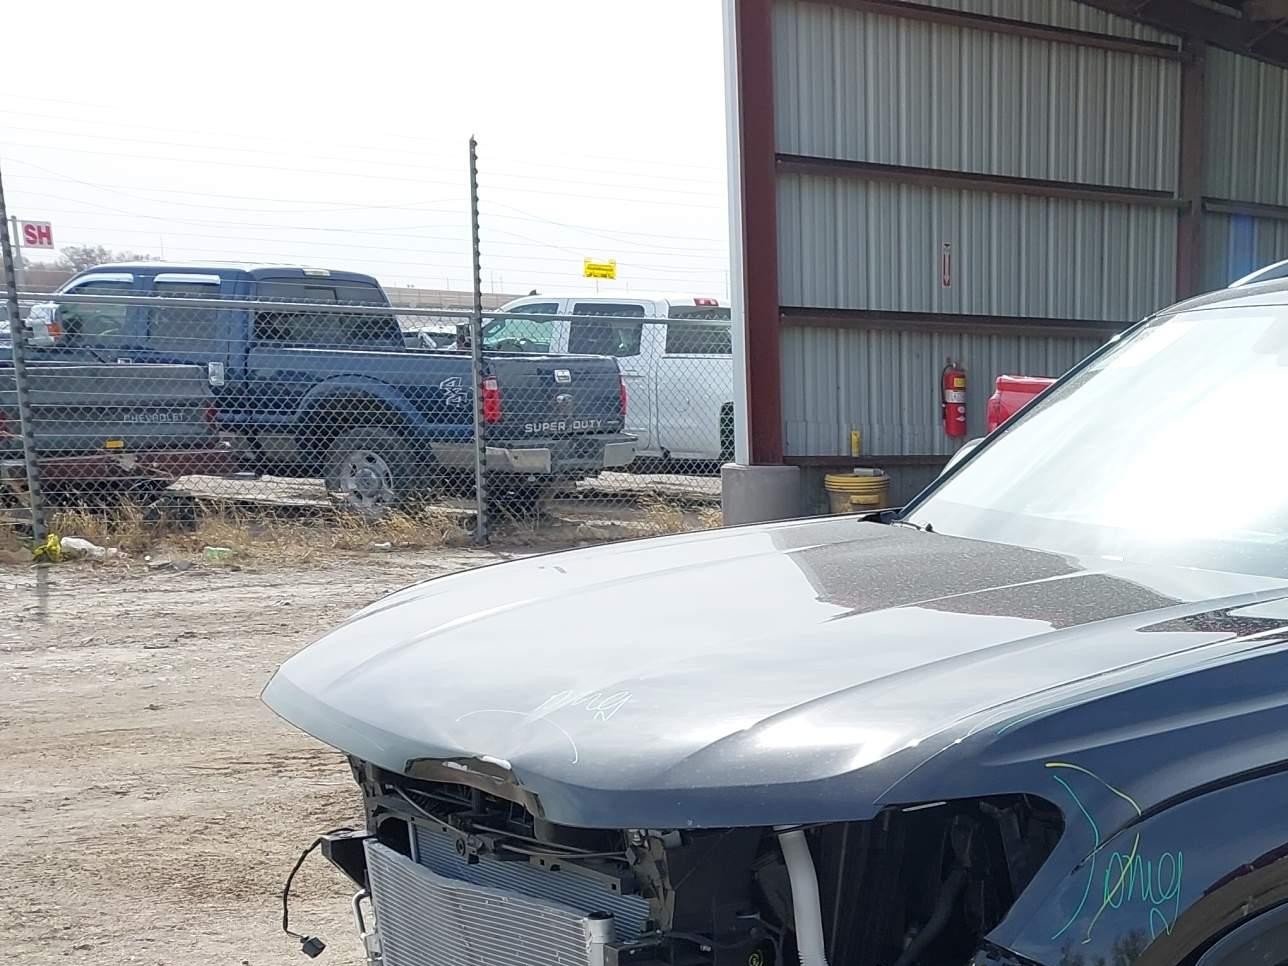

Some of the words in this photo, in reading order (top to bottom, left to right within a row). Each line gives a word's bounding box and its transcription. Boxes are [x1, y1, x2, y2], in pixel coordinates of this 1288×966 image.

[24, 224, 52, 245] SH
[525, 423, 566, 433] SUPER
[573, 420, 601, 430] DUTY
